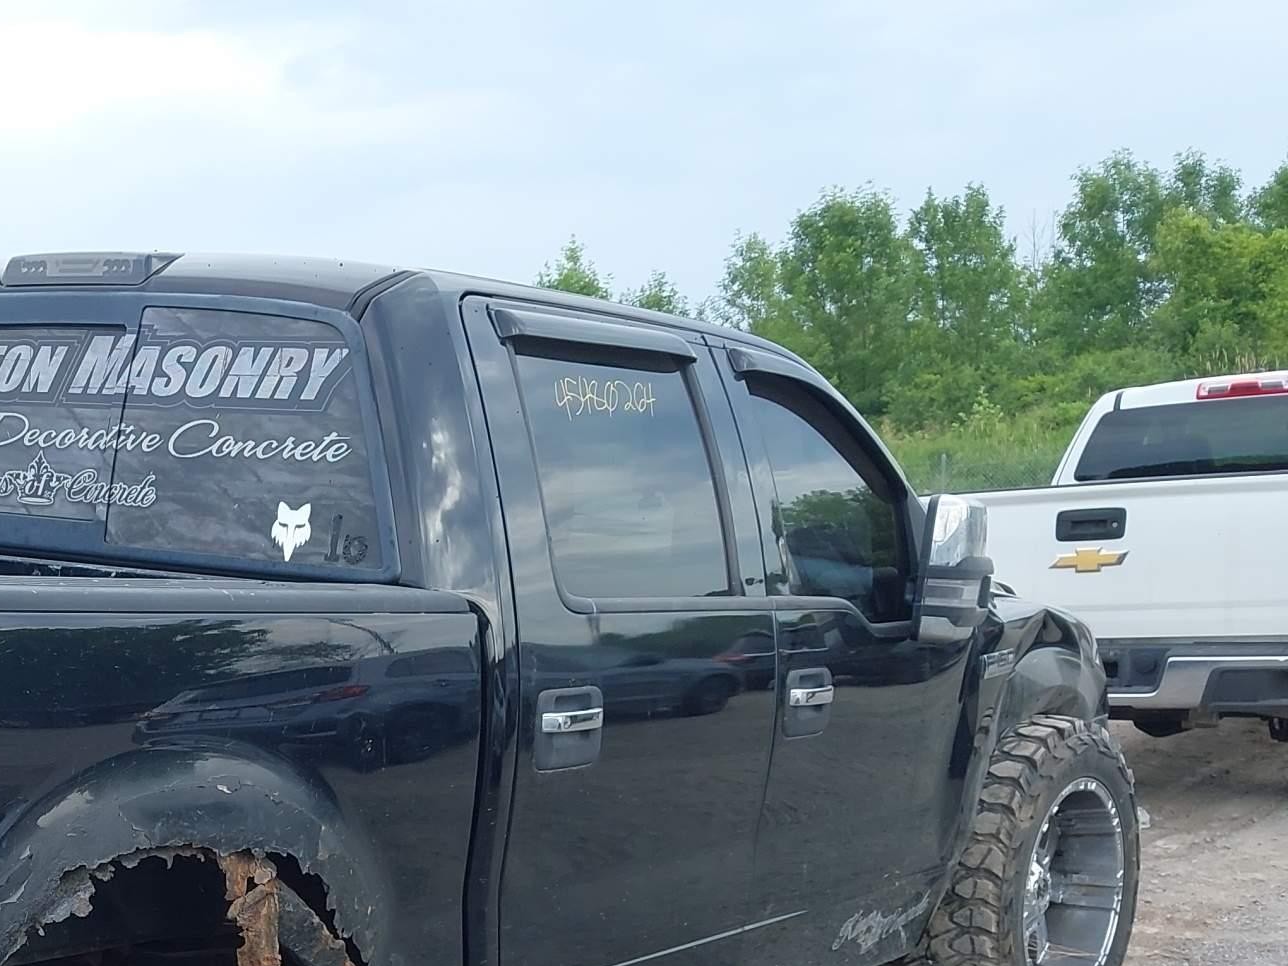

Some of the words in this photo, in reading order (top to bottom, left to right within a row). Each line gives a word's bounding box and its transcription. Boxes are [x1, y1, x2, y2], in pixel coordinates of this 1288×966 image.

[67, 333, 350, 401] MASONRY
[167, 419, 353, 463] Concrete
[23, 472, 53, 497] of
[65, 468, 157, 508] Concrete
